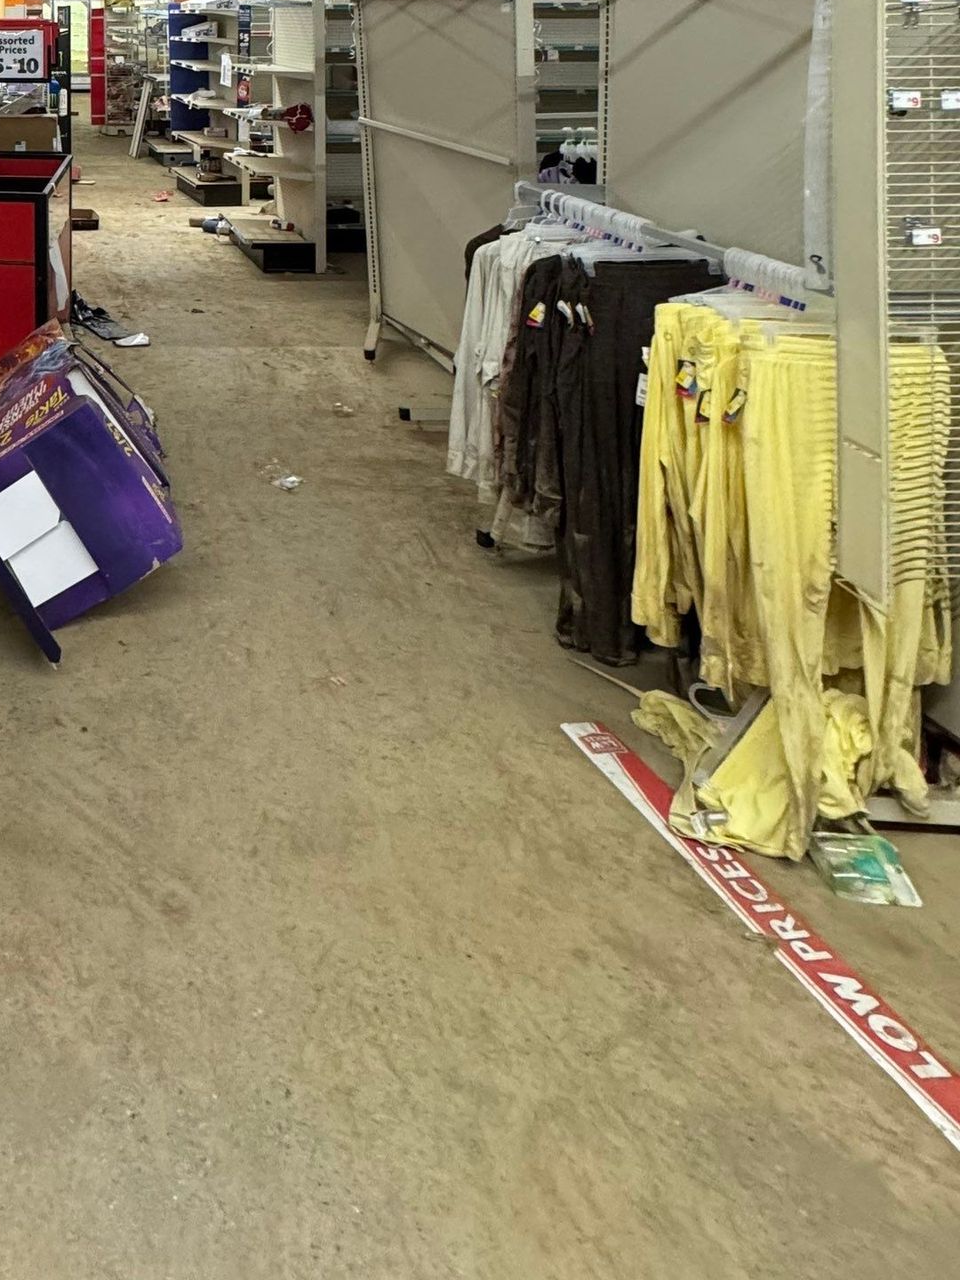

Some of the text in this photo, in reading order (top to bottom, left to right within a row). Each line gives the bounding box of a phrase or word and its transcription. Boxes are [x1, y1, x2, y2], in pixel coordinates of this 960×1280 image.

[24, 385, 69, 429] Takis
[697, 845, 952, 1080] LOW PRICES
